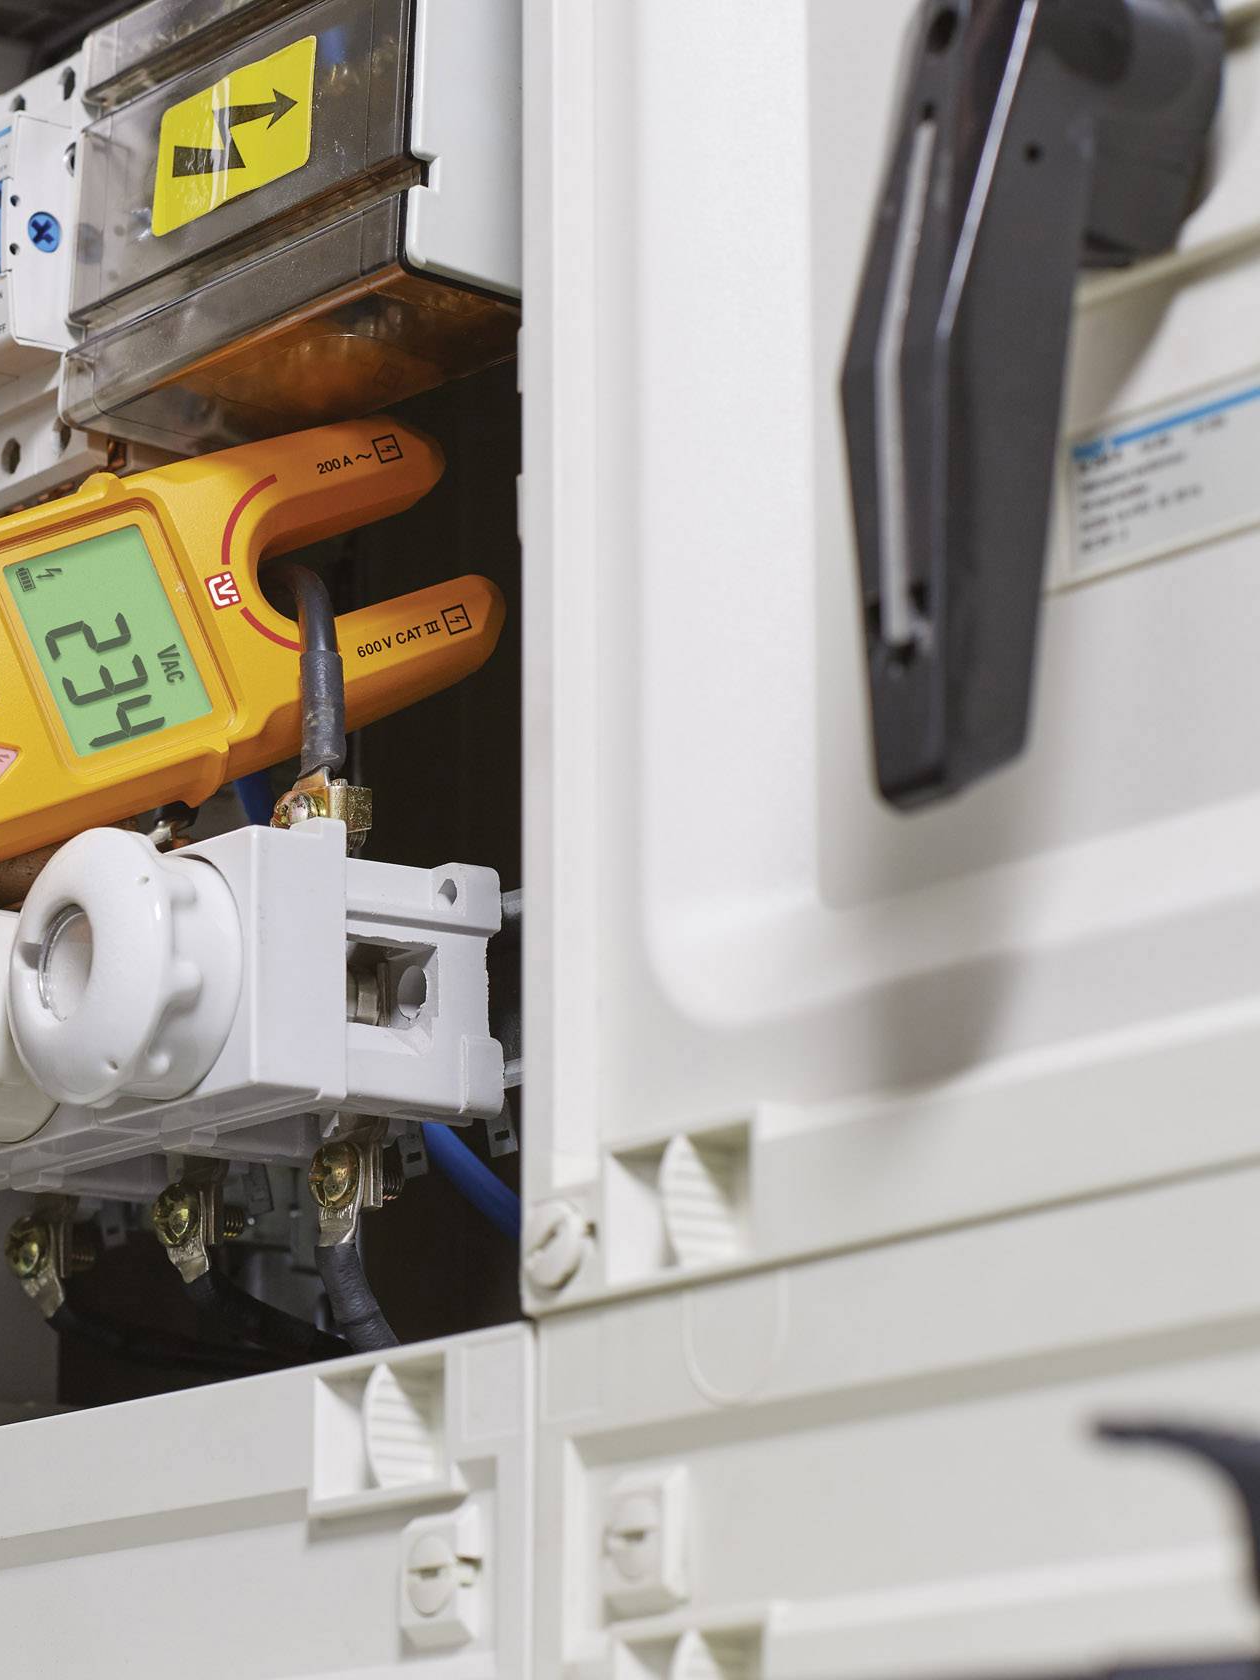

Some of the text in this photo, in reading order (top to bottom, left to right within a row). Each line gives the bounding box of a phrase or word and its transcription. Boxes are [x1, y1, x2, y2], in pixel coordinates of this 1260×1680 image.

[316, 458, 341, 475] 200
[395, 626, 423, 646] CAT
[157, 643, 185, 684] VAC
[45, 612, 165, 747] 234
